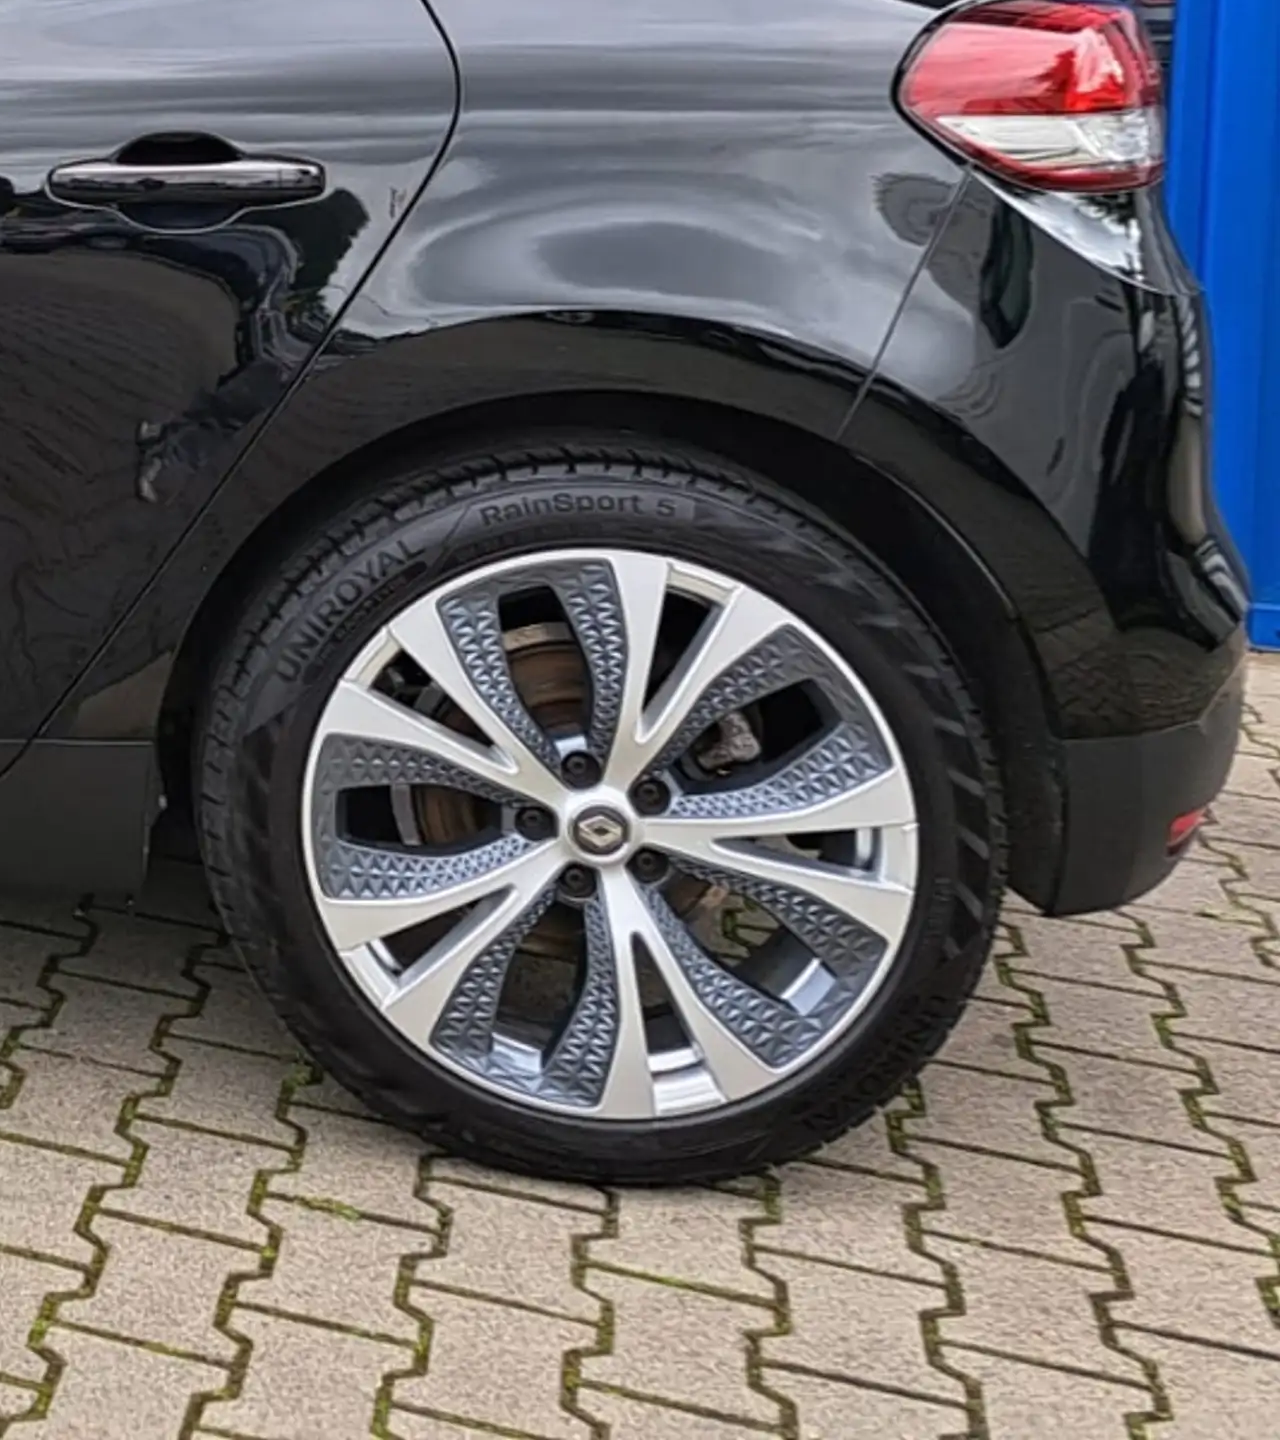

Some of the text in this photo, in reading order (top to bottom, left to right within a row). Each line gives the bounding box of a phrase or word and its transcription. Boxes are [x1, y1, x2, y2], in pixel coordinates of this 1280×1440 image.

[478, 492, 677, 527] RainSport 5
[275, 539, 427, 683] UNIROYAL
